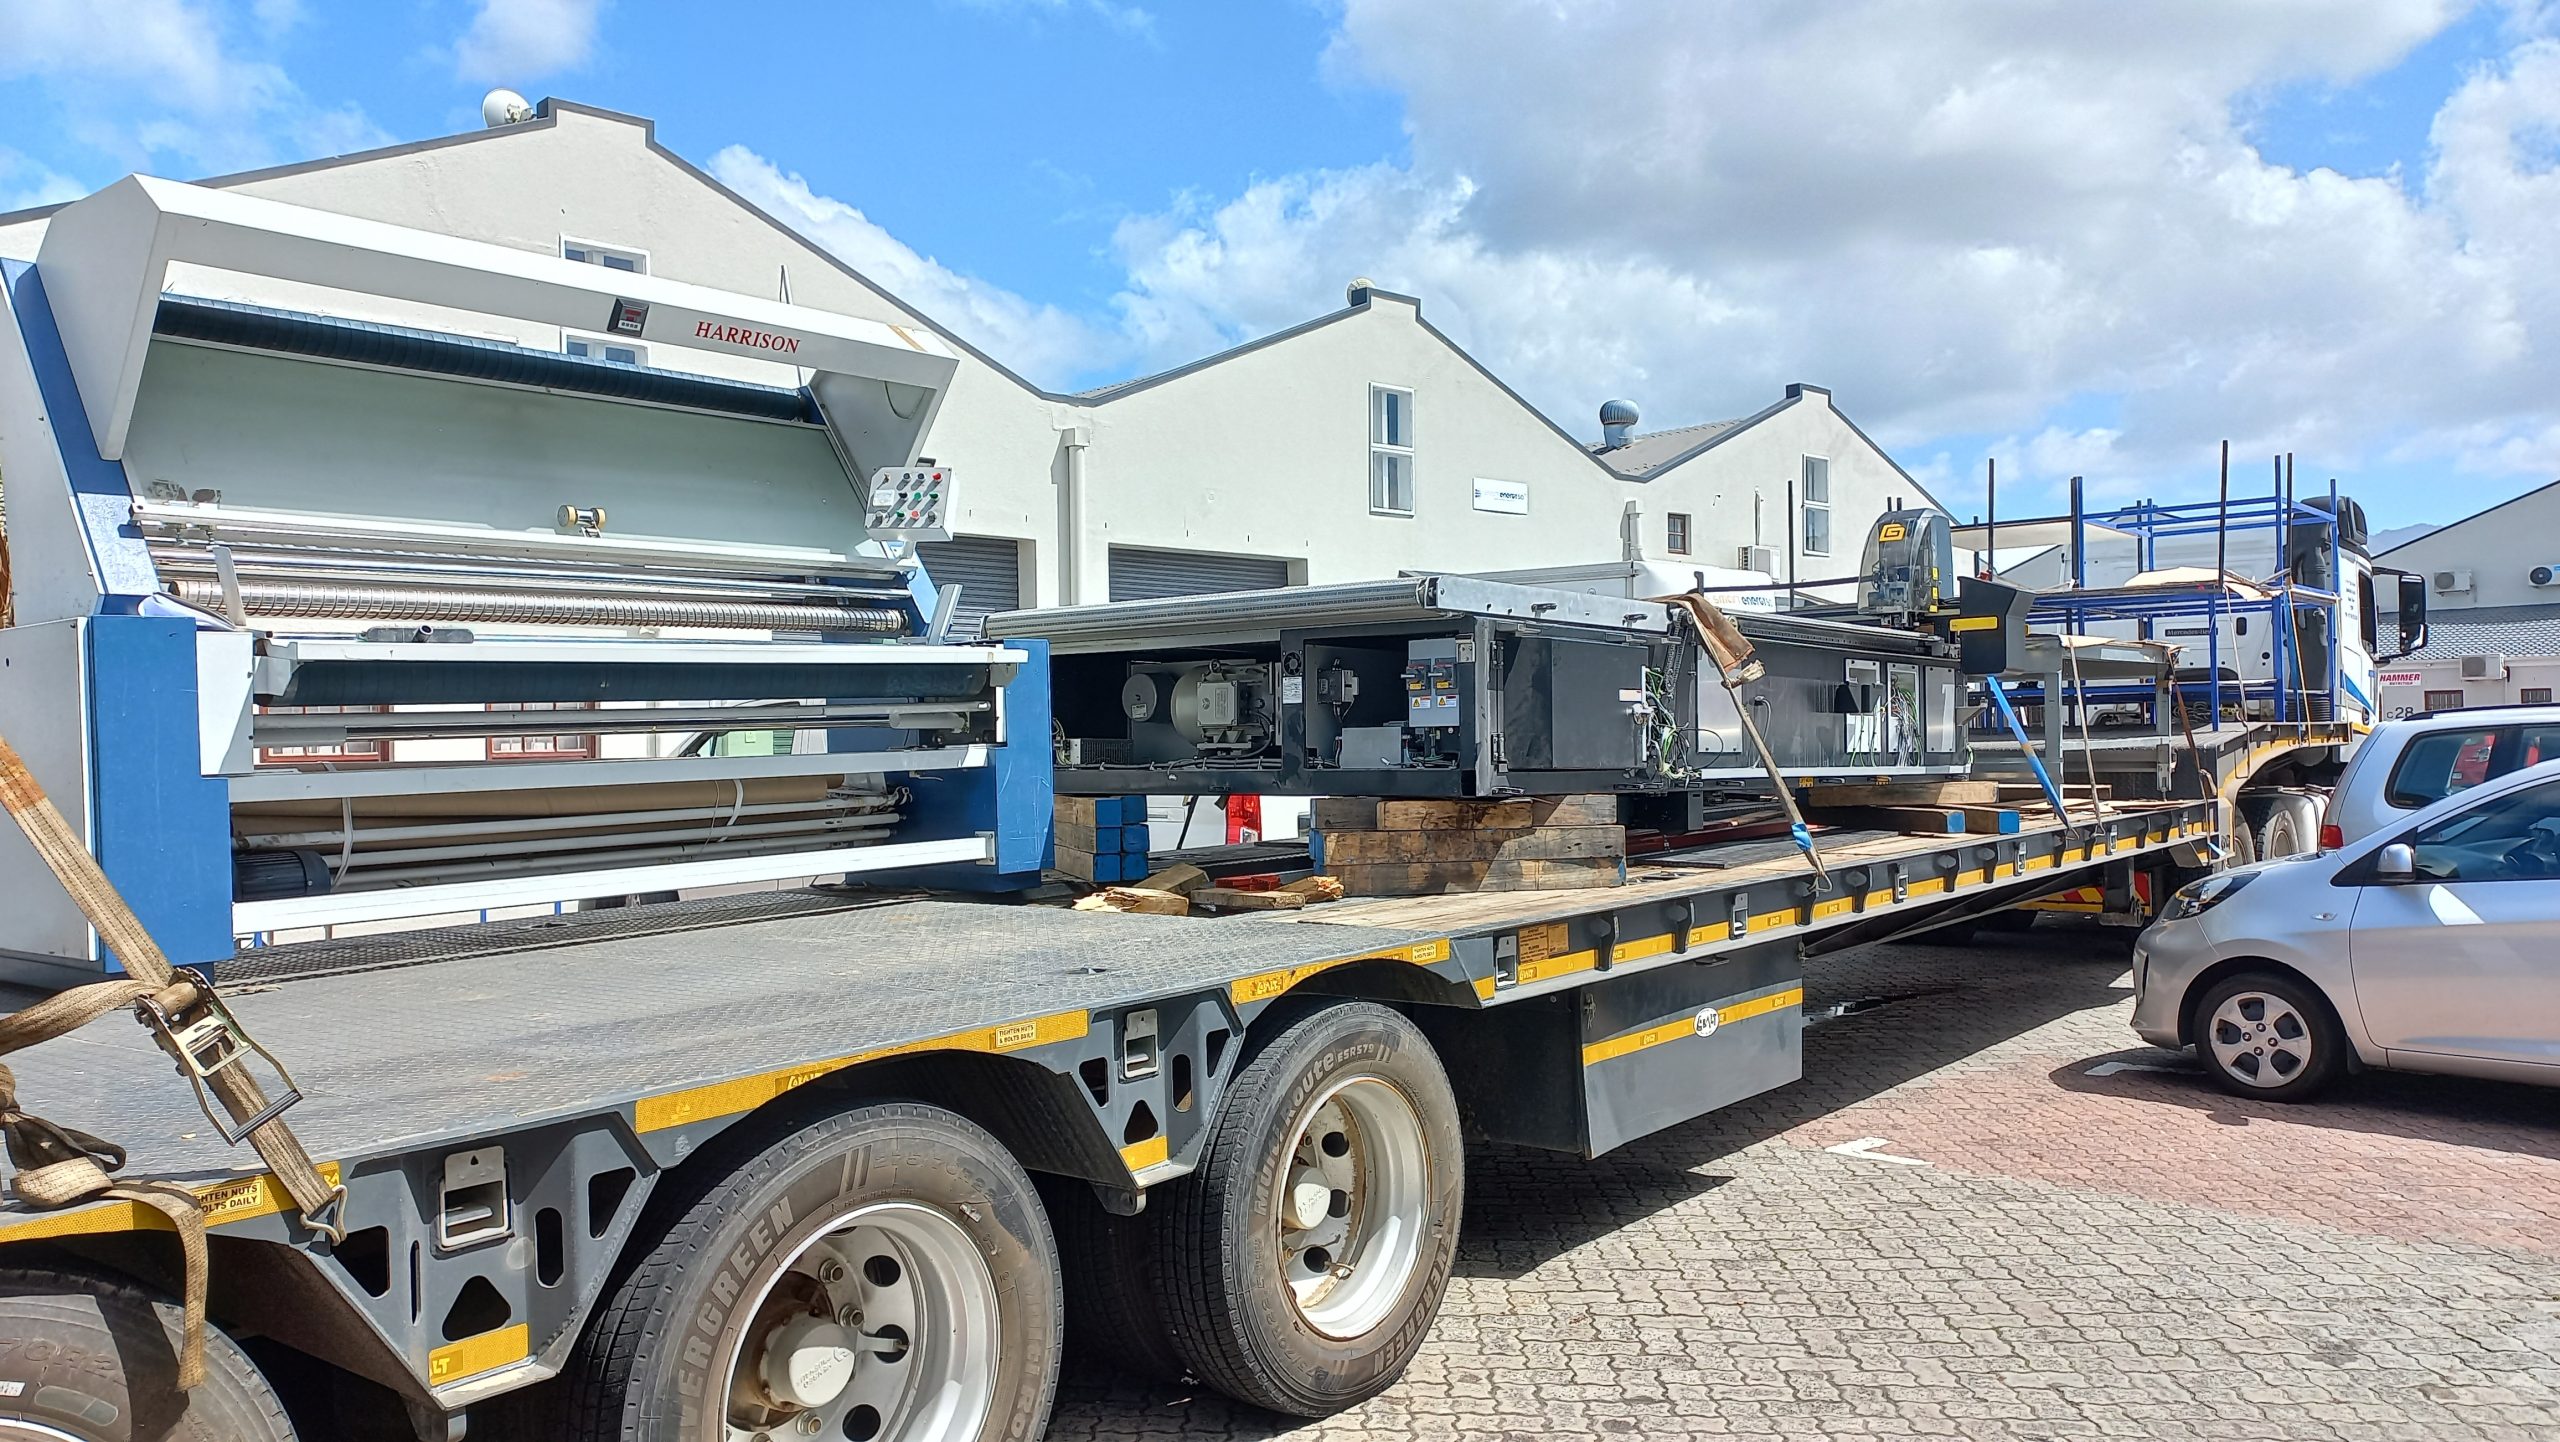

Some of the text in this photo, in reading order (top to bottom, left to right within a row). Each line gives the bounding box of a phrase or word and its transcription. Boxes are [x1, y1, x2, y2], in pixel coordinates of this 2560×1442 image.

[695, 320, 800, 354] HARRISON
[2166, 629, 2210, 637] Mercedes-Be
[2380, 673, 2421, 682] HAMMER
[1336, 1043, 1375, 1063] ESR579
[198, 1184, 258, 1205] HTEN NUTS
[201, 1194, 258, 1214] OLTS DAILY
